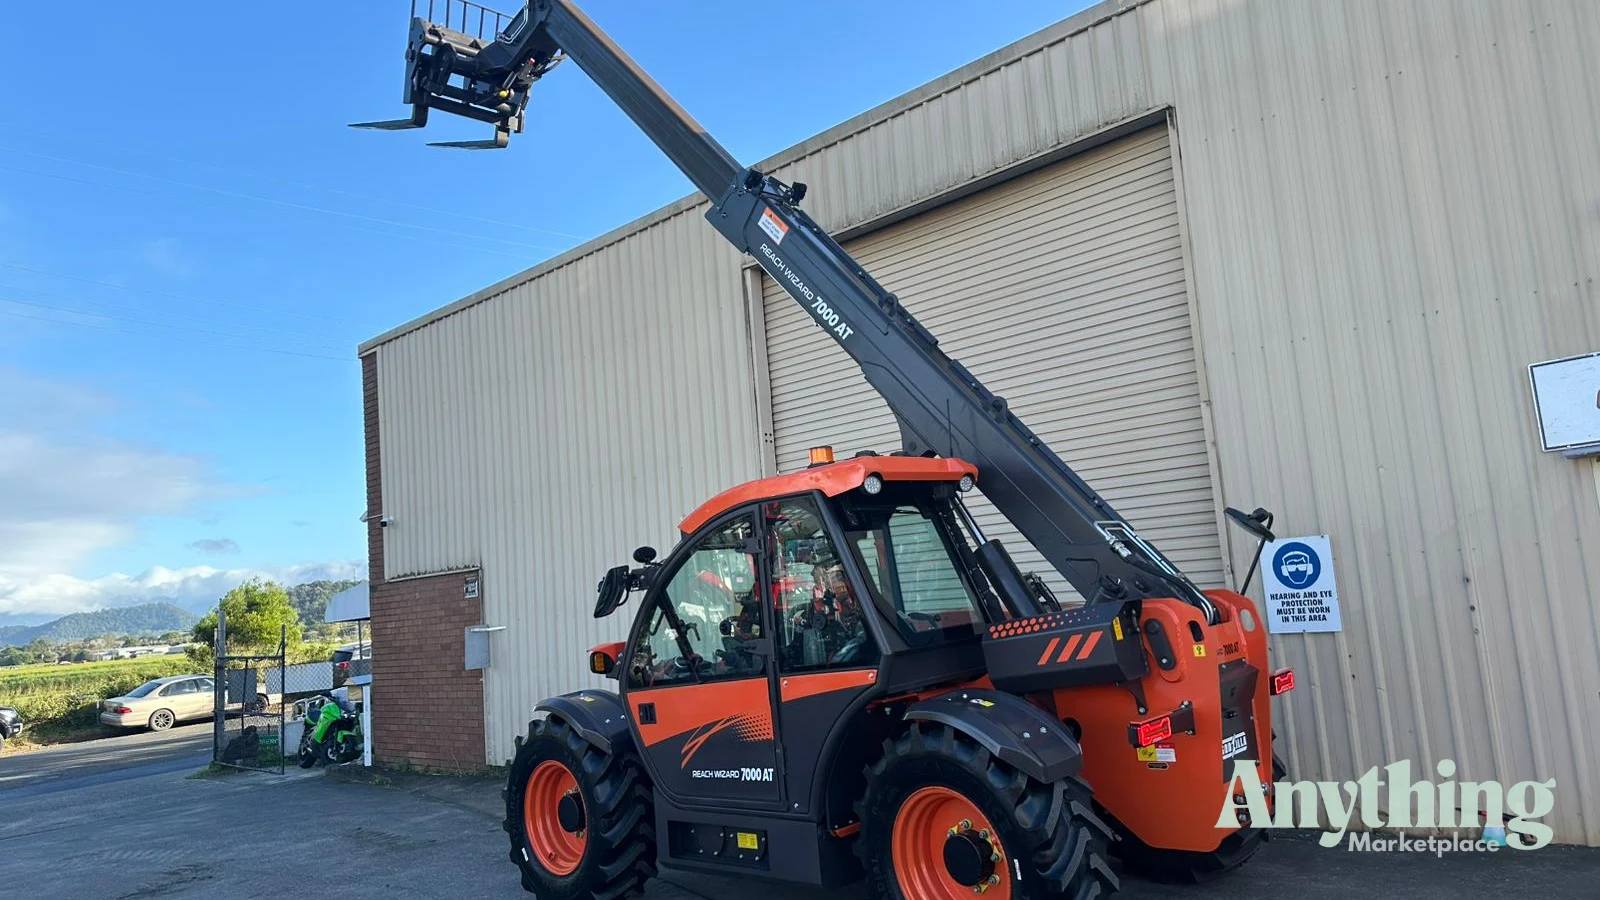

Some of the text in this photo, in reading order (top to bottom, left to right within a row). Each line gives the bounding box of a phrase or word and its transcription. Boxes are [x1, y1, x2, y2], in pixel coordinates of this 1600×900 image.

[760, 243, 785, 271] REACH
[784, 268, 814, 301] WIZARD
[811, 296, 840, 327] 7000
[834, 322, 854, 340] AT
[1270, 590, 1333, 600] HEARING AND EYE
[1281, 599, 1323, 607] PROTECTION
[692, 767, 774, 781] REACH WIZARD 7000 AT
